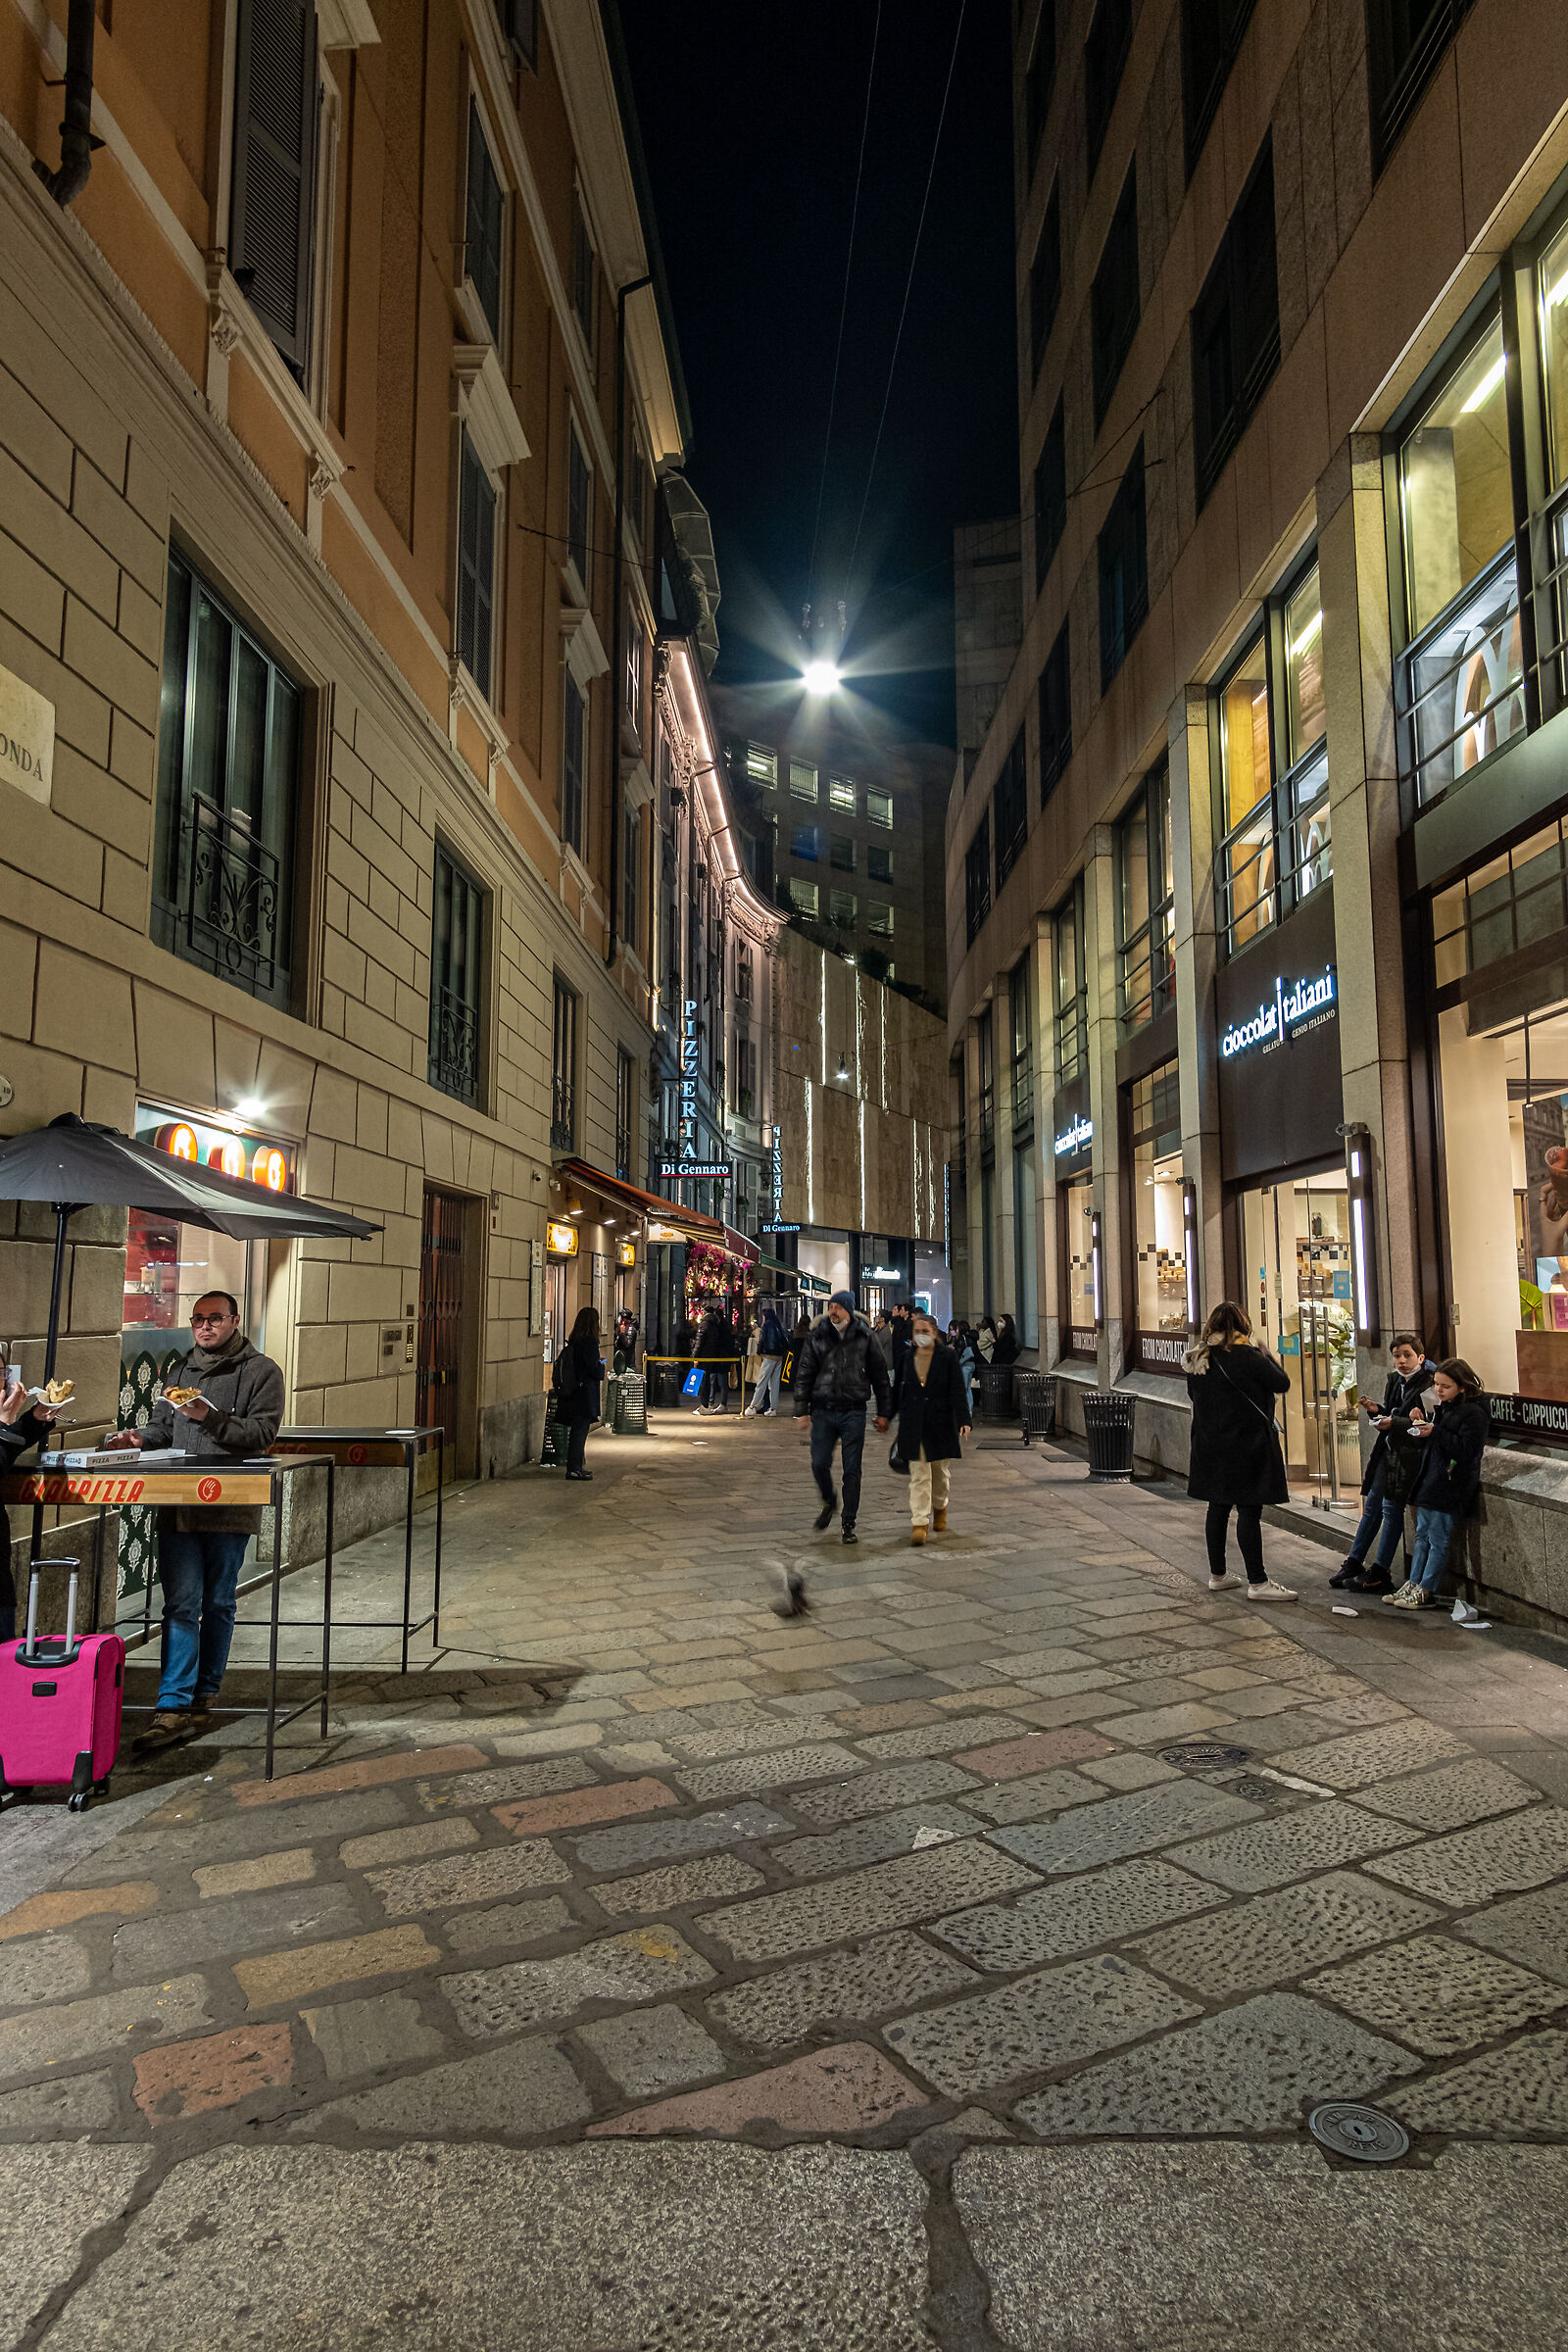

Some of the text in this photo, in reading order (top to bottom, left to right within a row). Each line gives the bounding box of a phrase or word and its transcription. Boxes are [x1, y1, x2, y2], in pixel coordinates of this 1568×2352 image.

[1292, 1023, 1308, 1039] GENIO
[1308, 1008, 1336, 1030] ITALIANO
[680, 1001, 699, 1158] PIZZERIA
[662, 1163, 729, 1175] Di Gennaro
[772, 1224, 800, 1233] Gennaro
[1142, 1338, 1155, 1360] FROM
[1490, 1397, 1515, 1422] CAFFÈ
